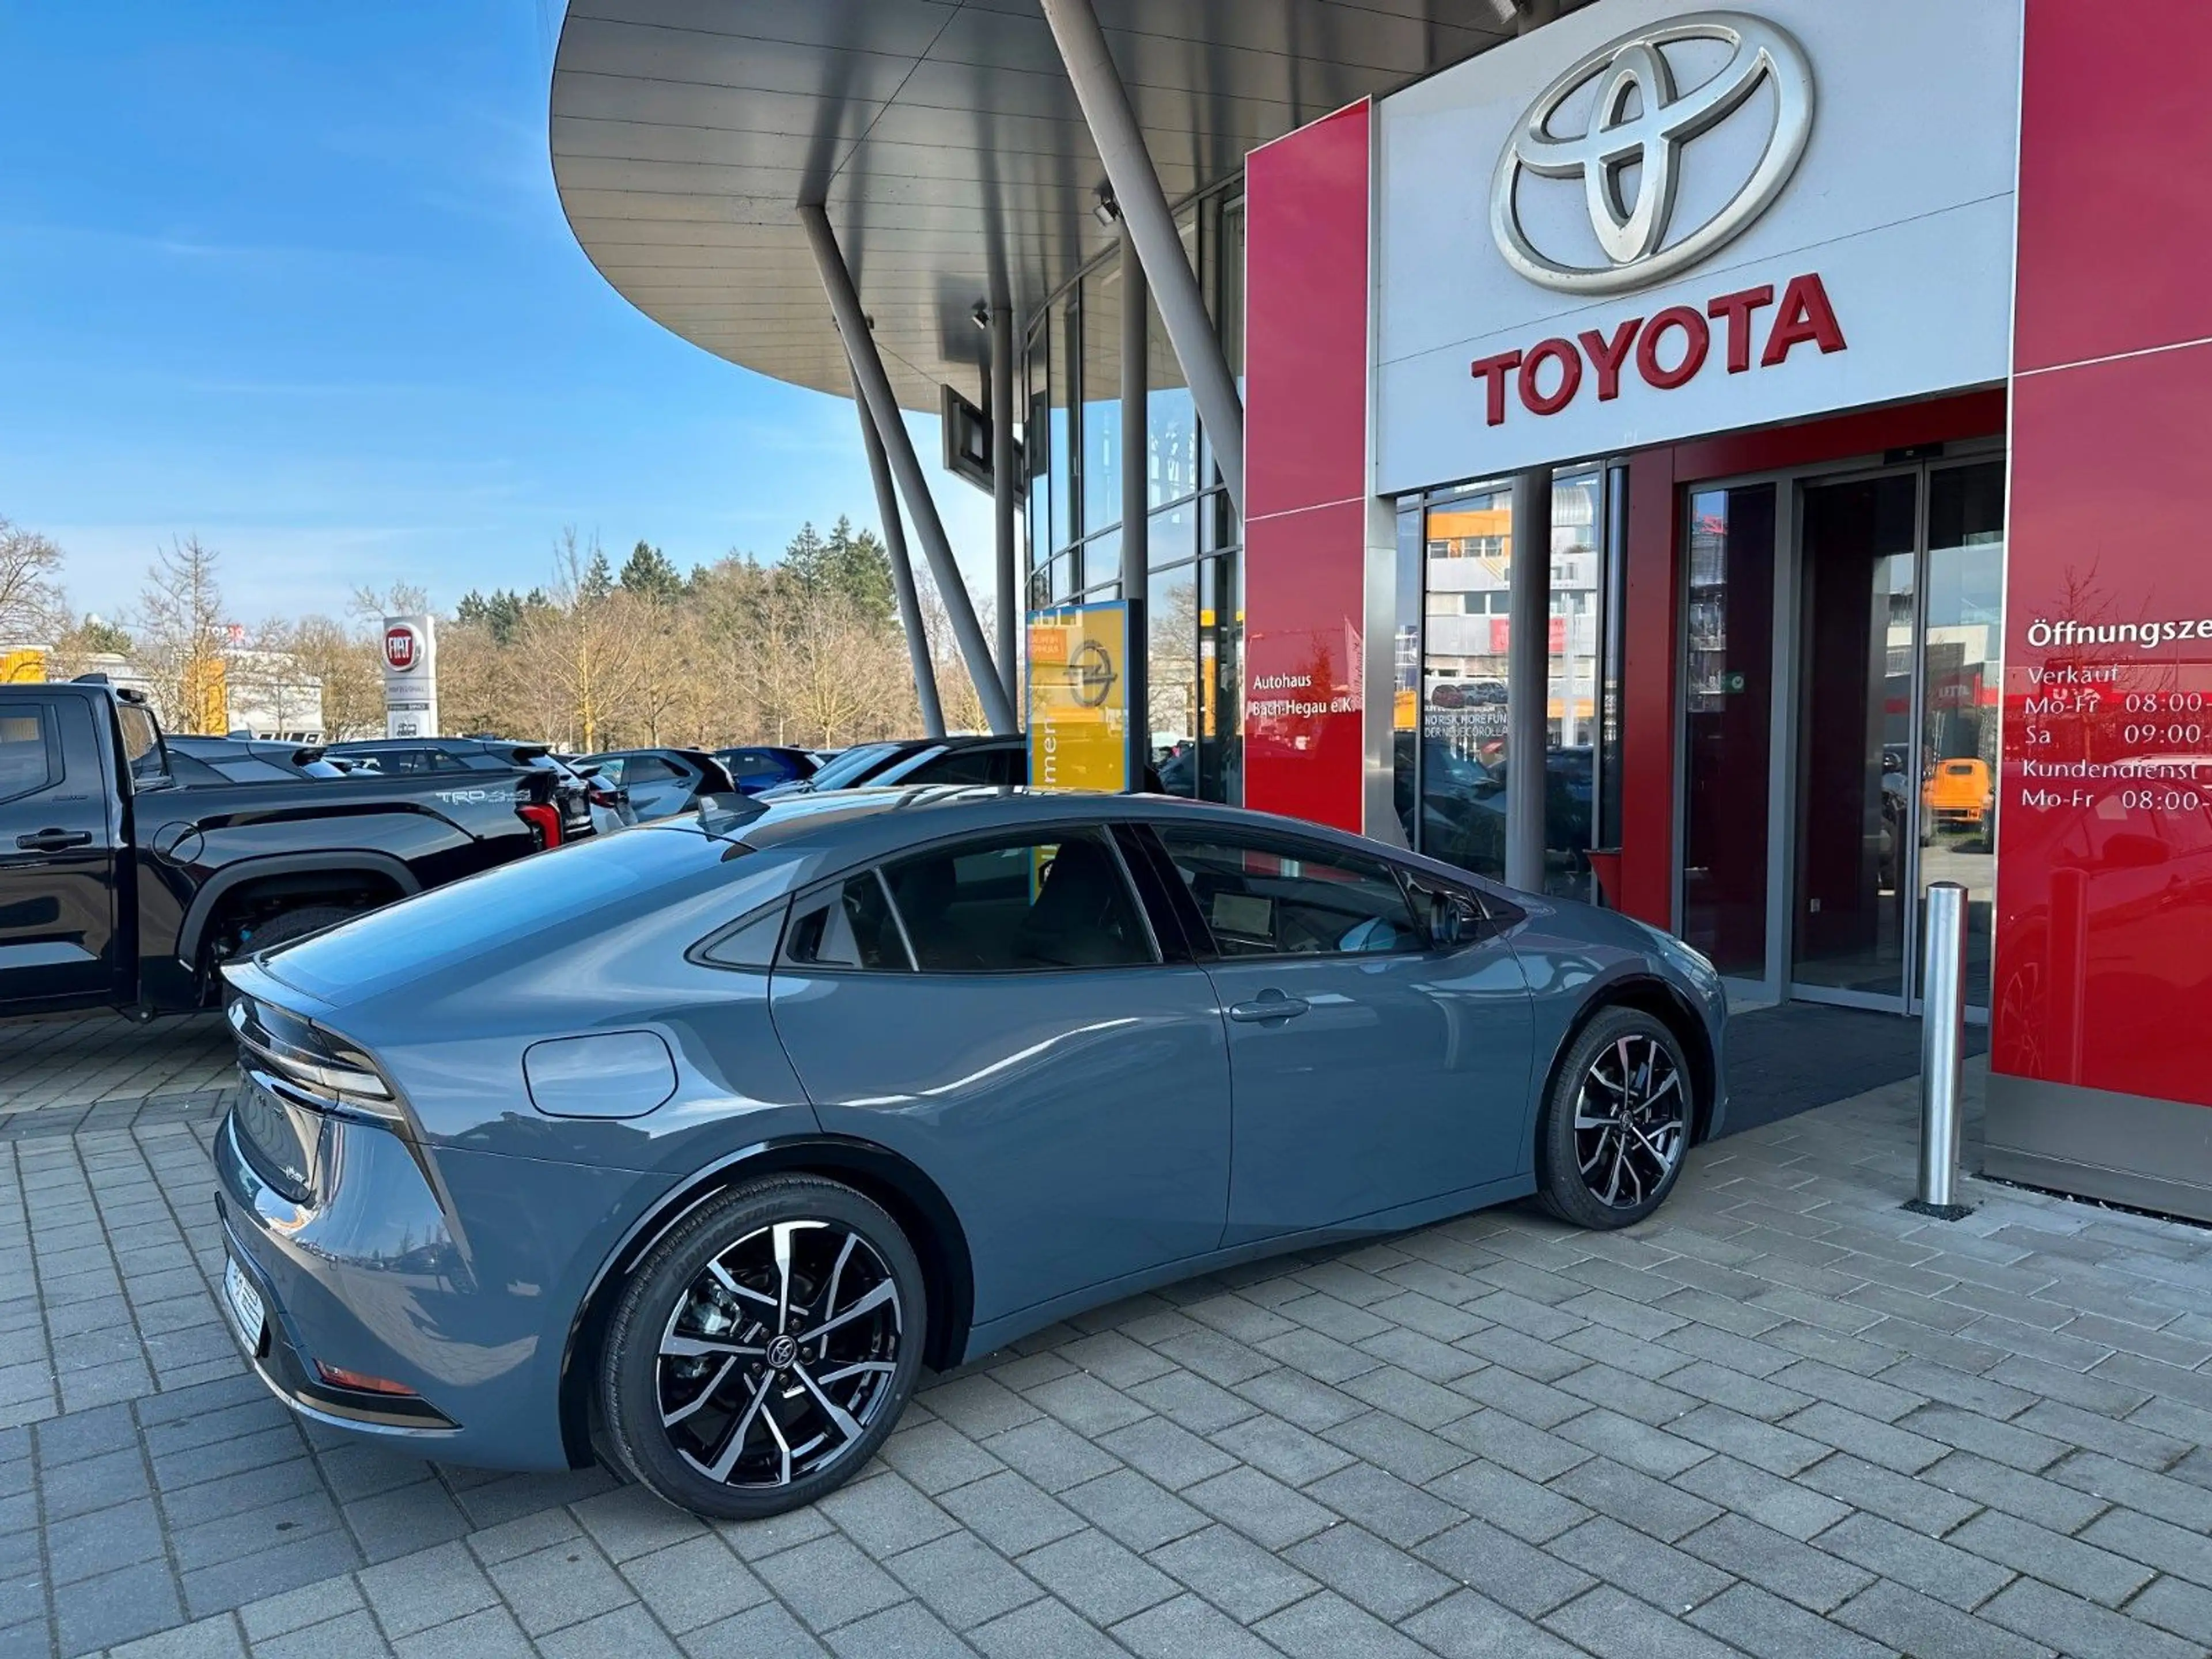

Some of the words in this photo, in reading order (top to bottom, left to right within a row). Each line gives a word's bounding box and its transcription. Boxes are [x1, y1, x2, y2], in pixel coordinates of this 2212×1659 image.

[1472, 273, 1847, 426] TOYOTA
[388, 636, 411, 659] FIAT
[1253, 672, 1312, 690] Autohaus
[2028, 664, 2119, 684] Verkauf
[1253, 699, 1326, 718] Bach-Hegau
[1331, 697, 1355, 713] e.K.
[2025, 695, 2099, 714] Mo-Fr
[1425, 715, 1437, 725] NO
[1461, 714, 1486, 724] MORE
[1488, 713, 1507, 724] FUN
[2025, 725, 2051, 744] Sa
[2023, 759, 2199, 779] Kundendienst
[435, 790, 485, 805] TRD
[2022, 789, 2094, 807] Mo-Fr
